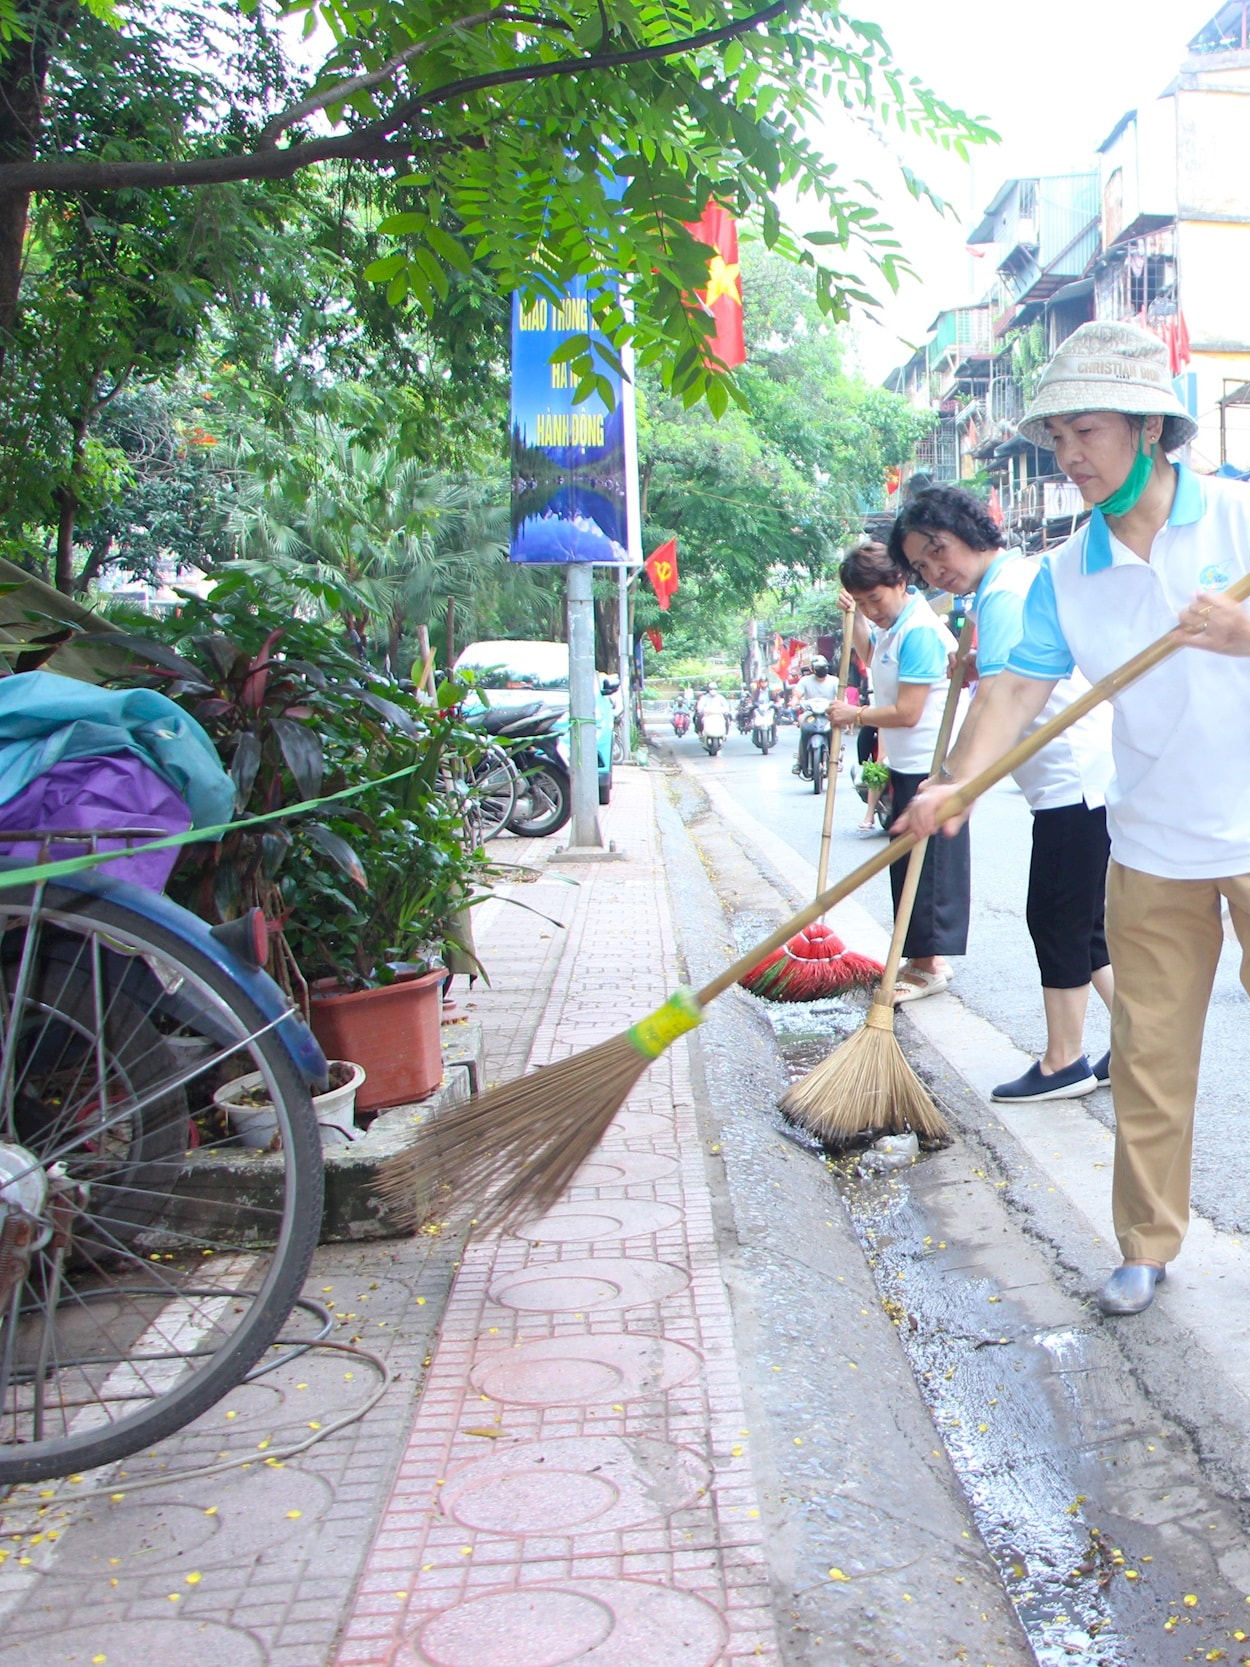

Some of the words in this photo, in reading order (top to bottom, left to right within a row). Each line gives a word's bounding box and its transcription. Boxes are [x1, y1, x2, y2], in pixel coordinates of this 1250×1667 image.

[1077, 361, 1137, 378] CHRISTIAN
[536, 407, 569, 447] HÀNH
[572, 407, 604, 454] ĐỘNG
